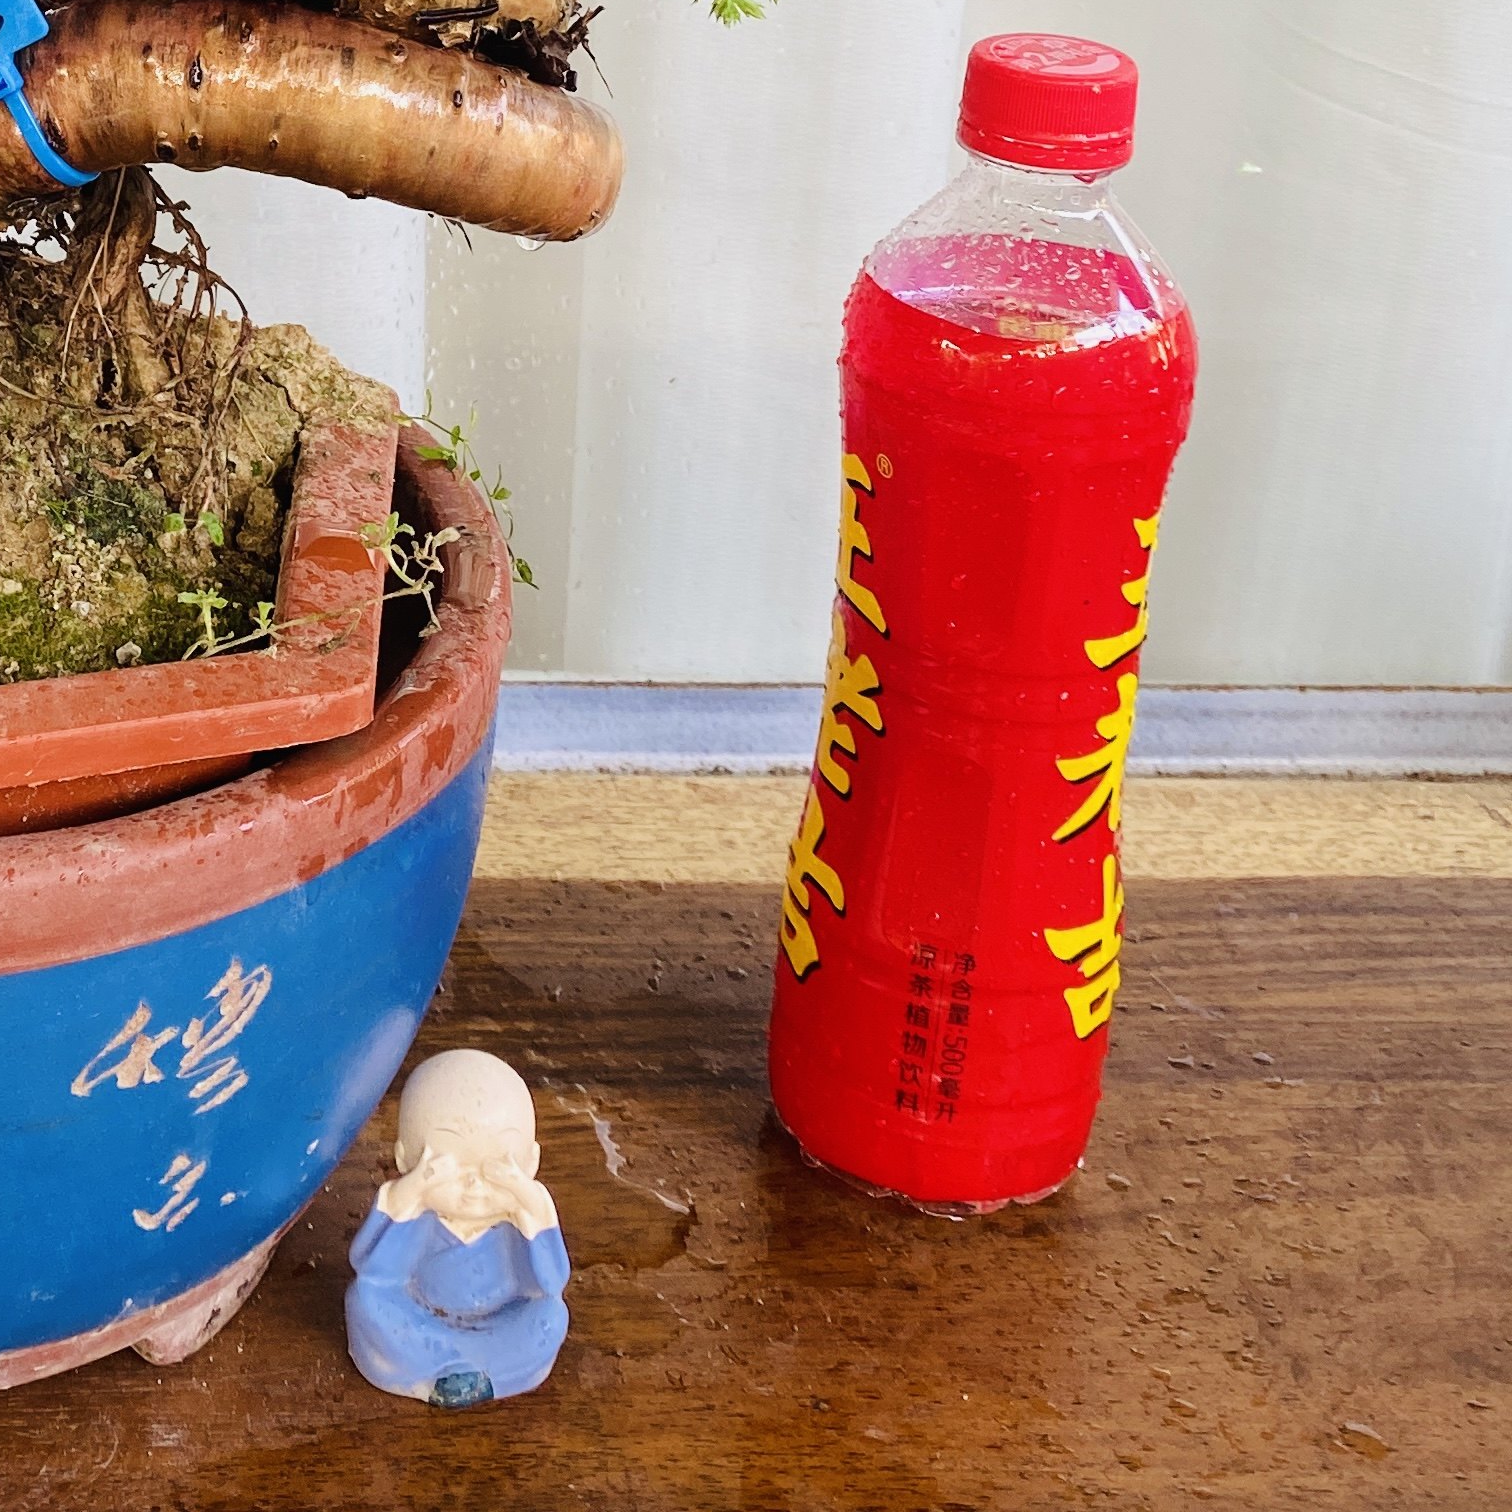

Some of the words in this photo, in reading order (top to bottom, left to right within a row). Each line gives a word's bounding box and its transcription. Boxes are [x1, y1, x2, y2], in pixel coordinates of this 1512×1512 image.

[895, 942, 938, 1113] 凉茶植物饮料
